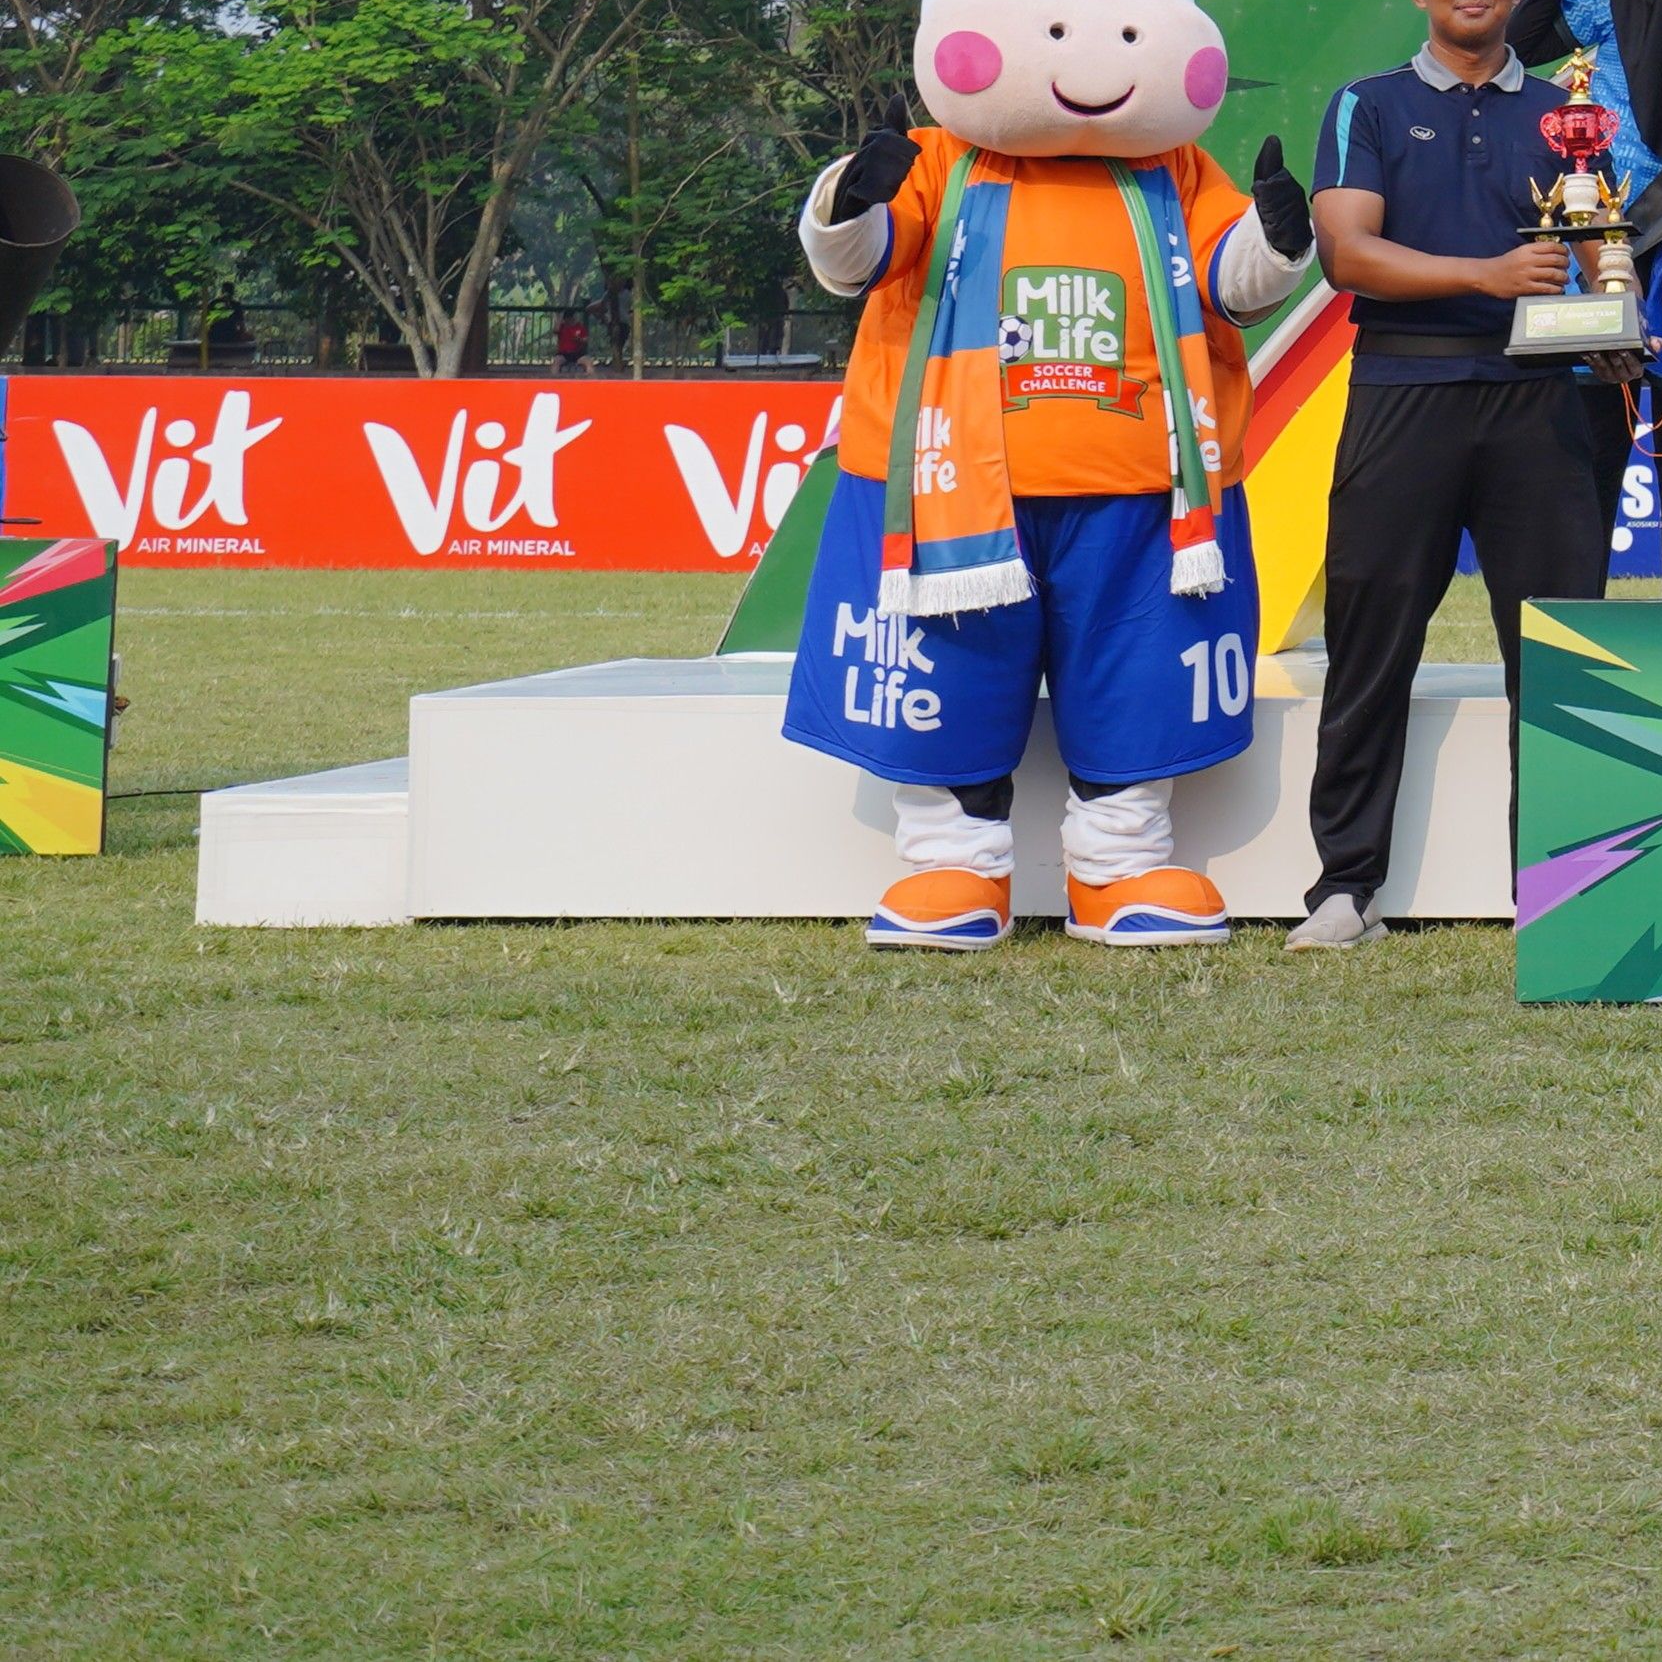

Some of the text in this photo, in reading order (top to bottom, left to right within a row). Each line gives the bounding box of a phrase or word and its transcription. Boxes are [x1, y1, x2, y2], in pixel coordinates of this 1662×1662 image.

[1017, 274, 1116, 322] Milk
[1033, 316, 1119, 362] Life
[1020, 379, 1106, 393] CHALLENGE
[1033, 365, 1093, 378] SOCCER
[53, 390, 283, 551] Vit
[363, 392, 592, 557] Vit
[137, 537, 266, 555] AIR MINERAL
[449, 539, 576, 557] AIR MINERAL
[833, 602, 935, 676] Milk
[843, 667, 943, 733] Life
[1180, 632, 1250, 724] 10
